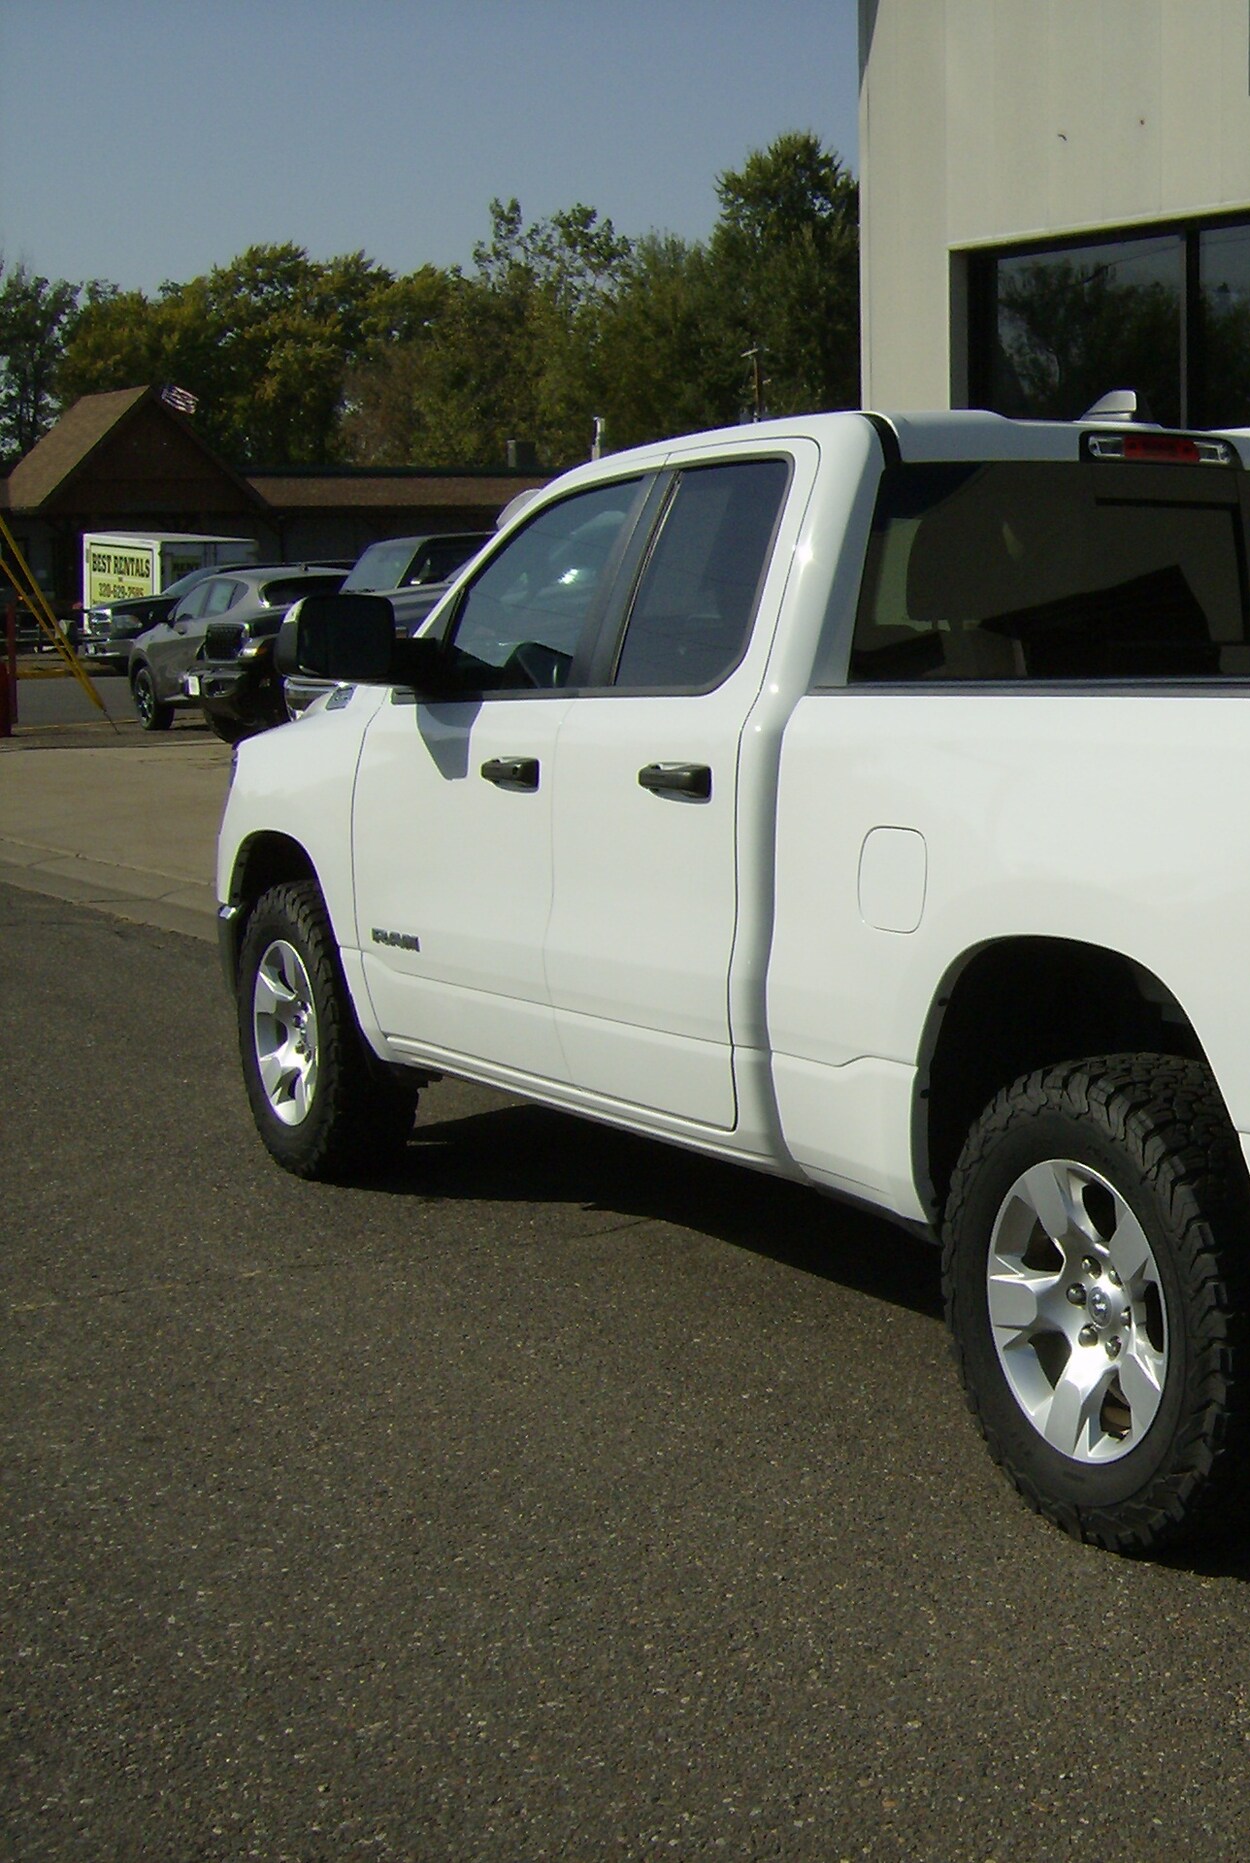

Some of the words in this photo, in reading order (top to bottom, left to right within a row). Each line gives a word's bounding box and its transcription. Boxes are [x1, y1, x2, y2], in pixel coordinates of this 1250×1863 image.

[92, 552, 112, 573] BEST
[113, 554, 151, 578] RENTALS
[371, 928, 421, 953] RAM
